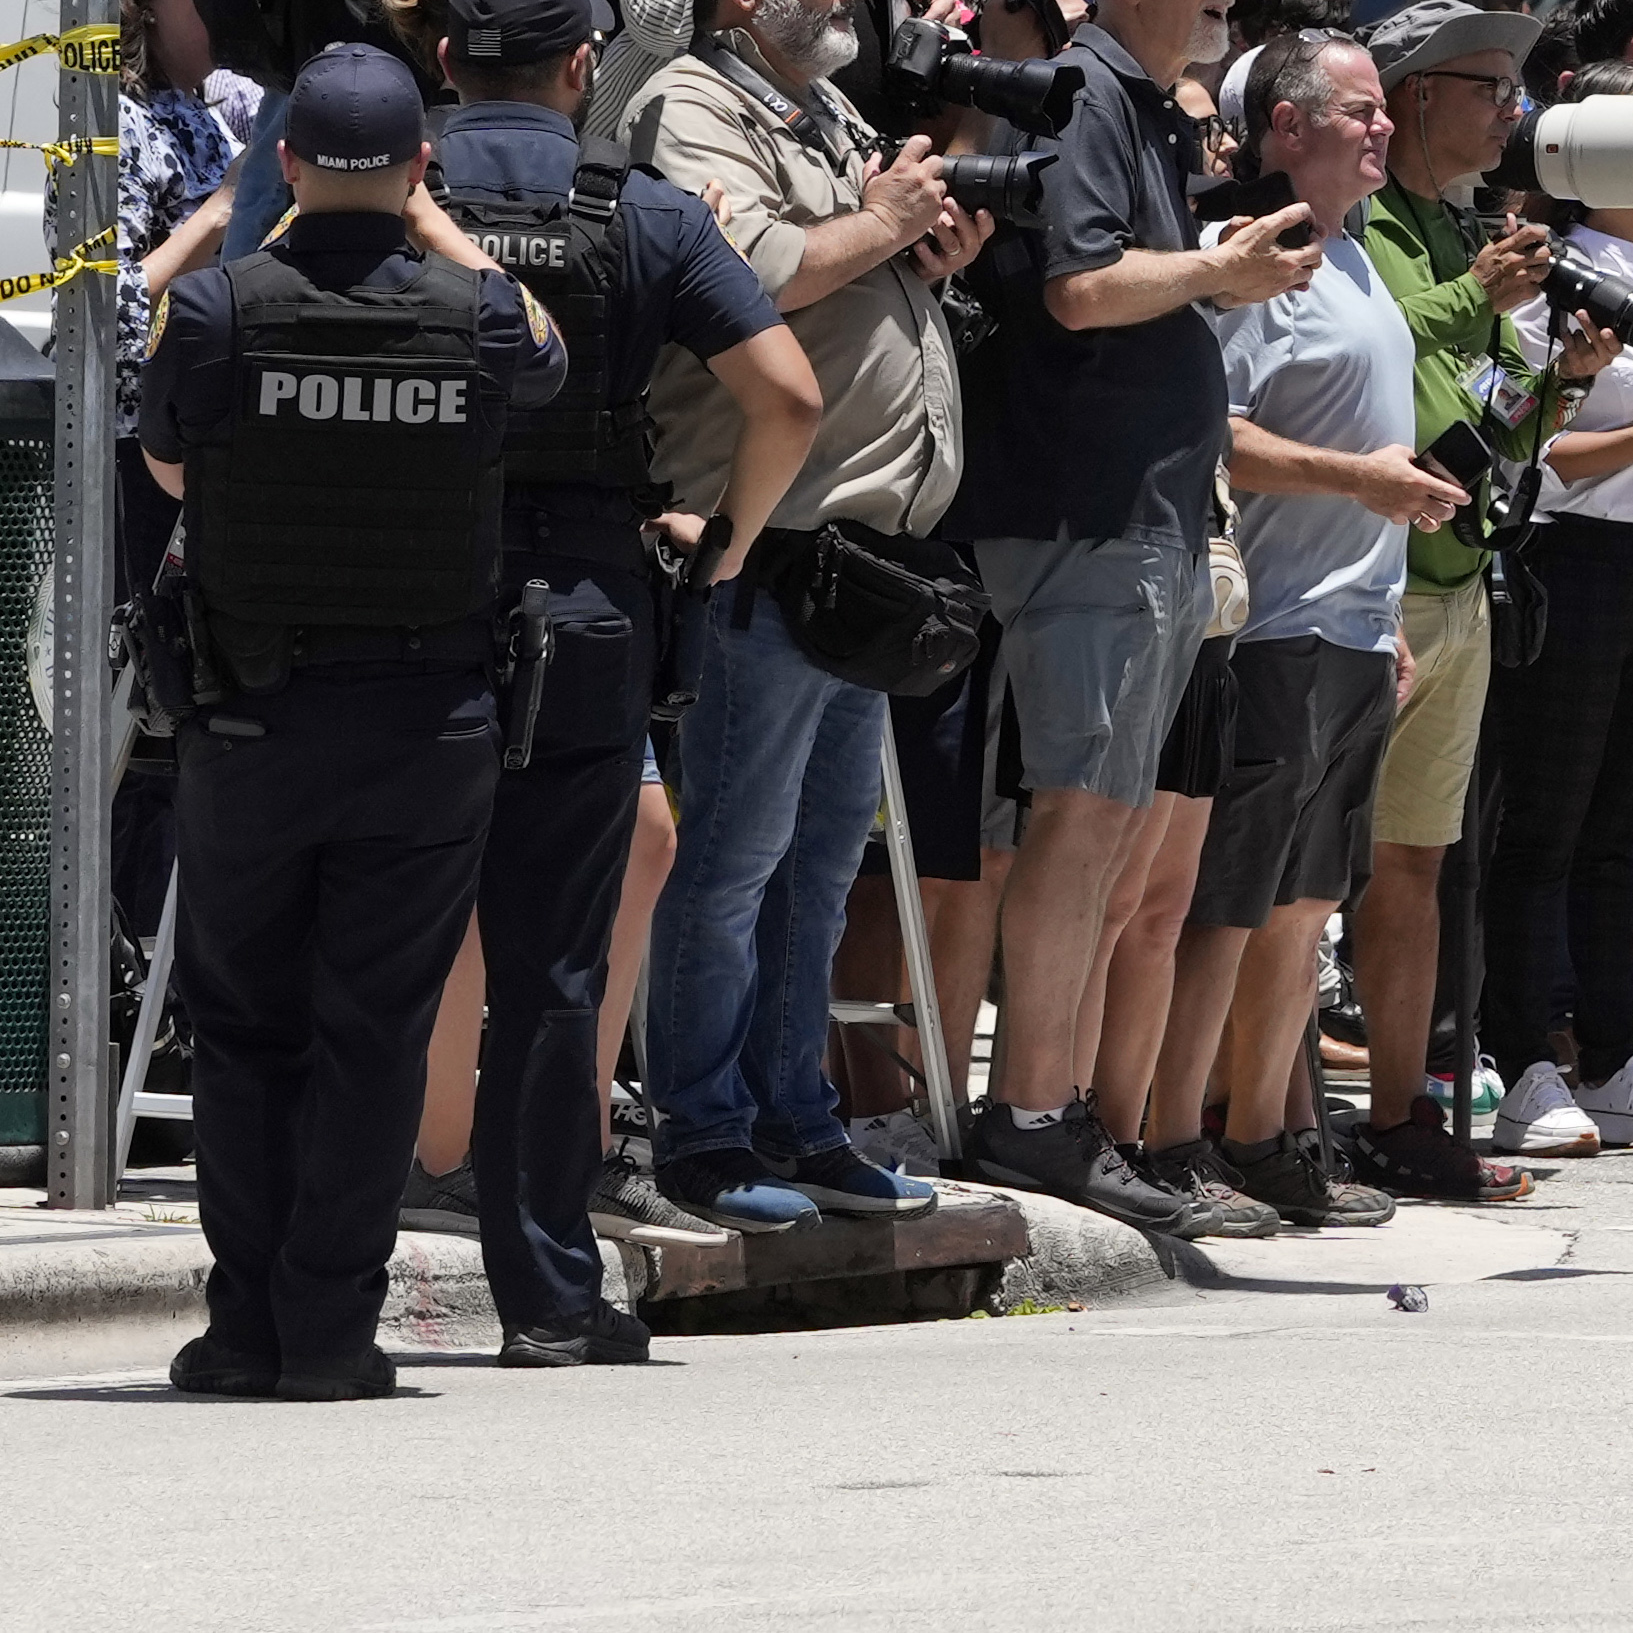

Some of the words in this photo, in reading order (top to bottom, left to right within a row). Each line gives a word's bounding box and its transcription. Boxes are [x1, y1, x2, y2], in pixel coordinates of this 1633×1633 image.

[316, 153, 348, 169] MIAMI
[350, 153, 391, 170] POLICE
[0, 275, 32, 300] DO
[258, 370, 467, 424] POLICE
